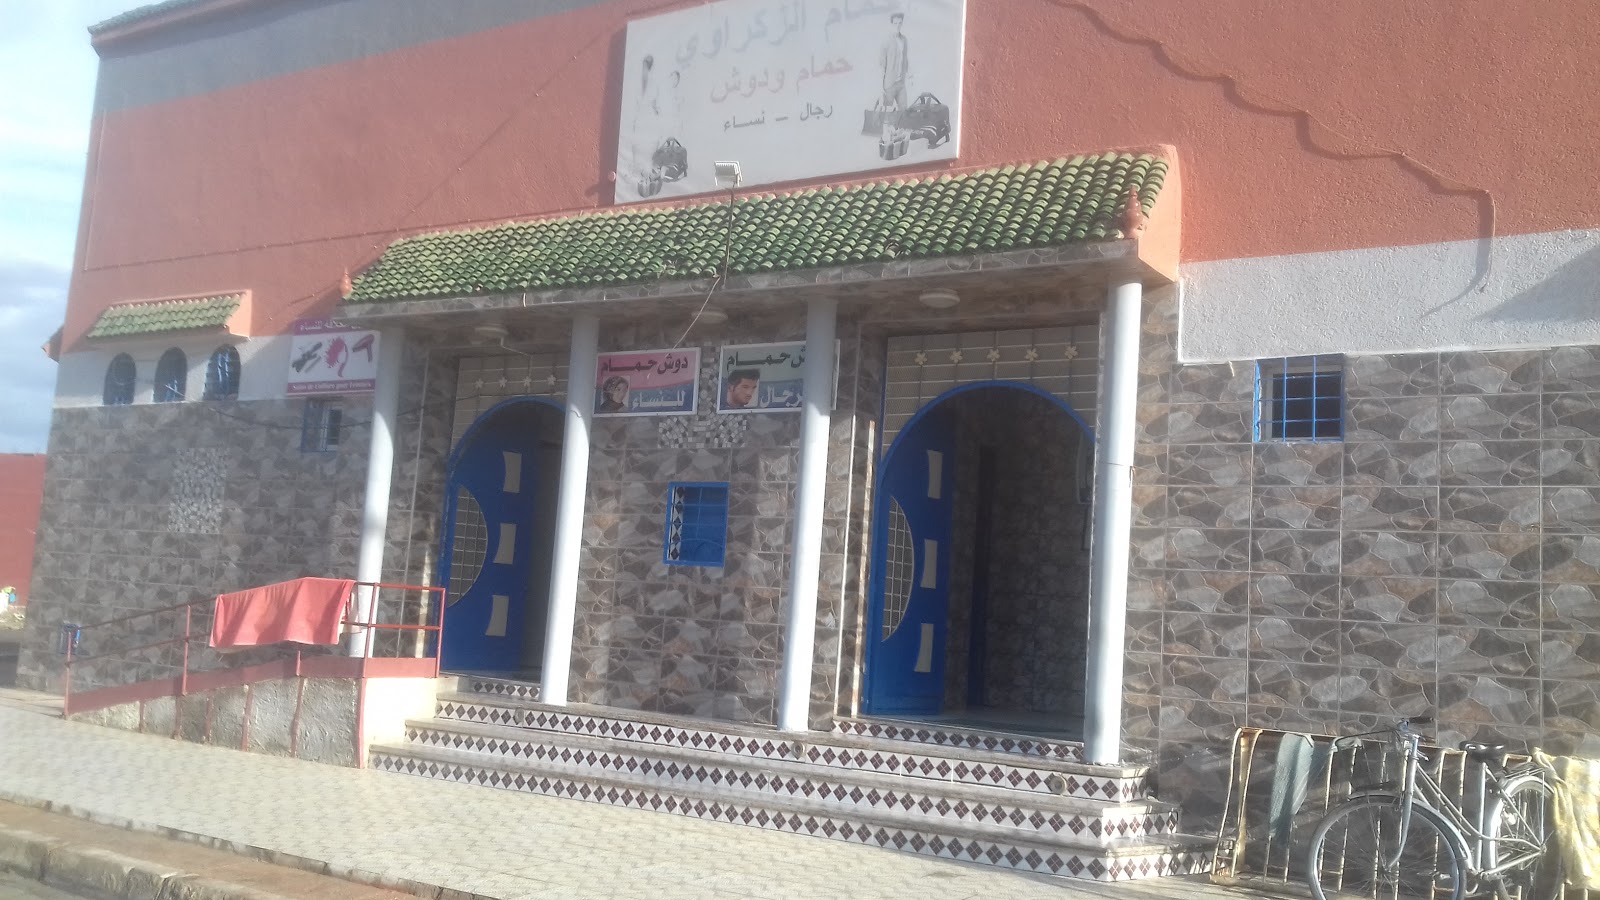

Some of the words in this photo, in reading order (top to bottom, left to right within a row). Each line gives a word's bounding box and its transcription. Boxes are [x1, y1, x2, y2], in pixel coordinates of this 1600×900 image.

[710, 66, 786, 104] ودوش
[794, 54, 855, 97] حمام
[722, 109, 766, 132] نساء
[799, 101, 834, 122] رجال
[600, 356, 658, 377] حمام
[656, 352, 689, 375] دوش
[726, 351, 792, 372] حمام
[631, 389, 687, 411] للنساء
